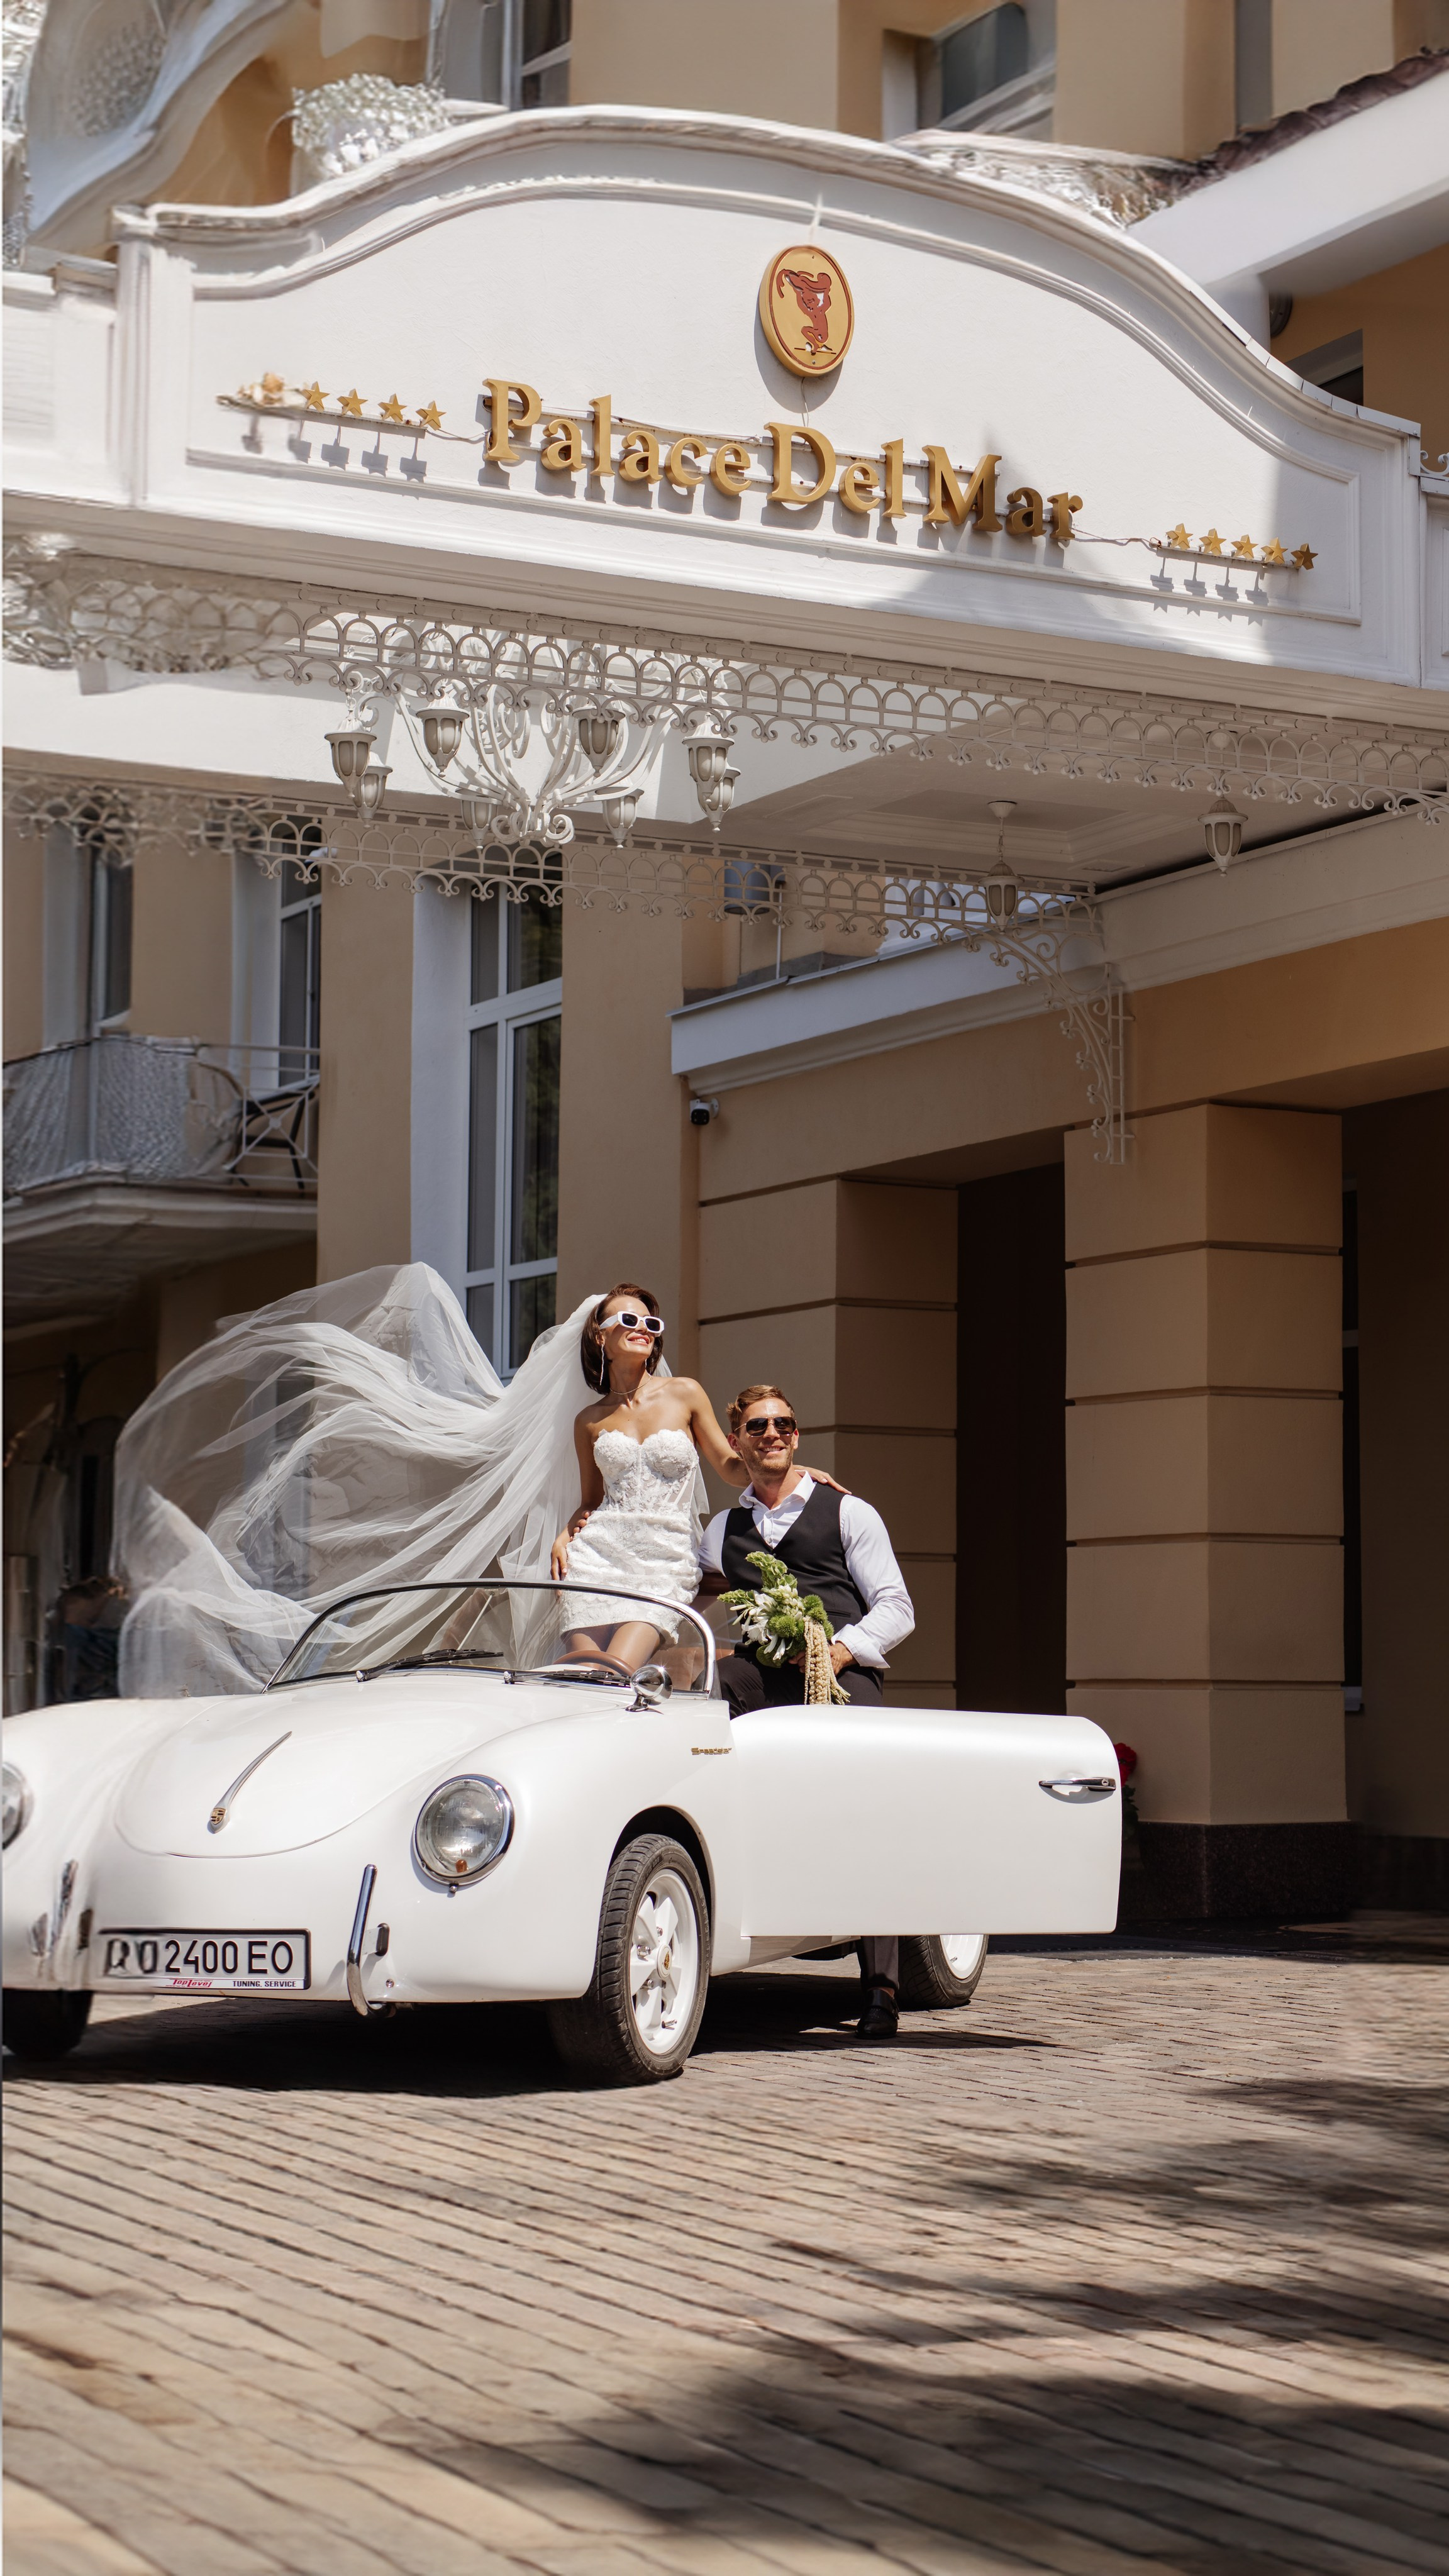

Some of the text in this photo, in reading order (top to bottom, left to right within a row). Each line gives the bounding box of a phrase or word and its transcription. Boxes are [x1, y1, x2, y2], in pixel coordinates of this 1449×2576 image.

[482, 378, 1083, 541] Palace Del Mar
